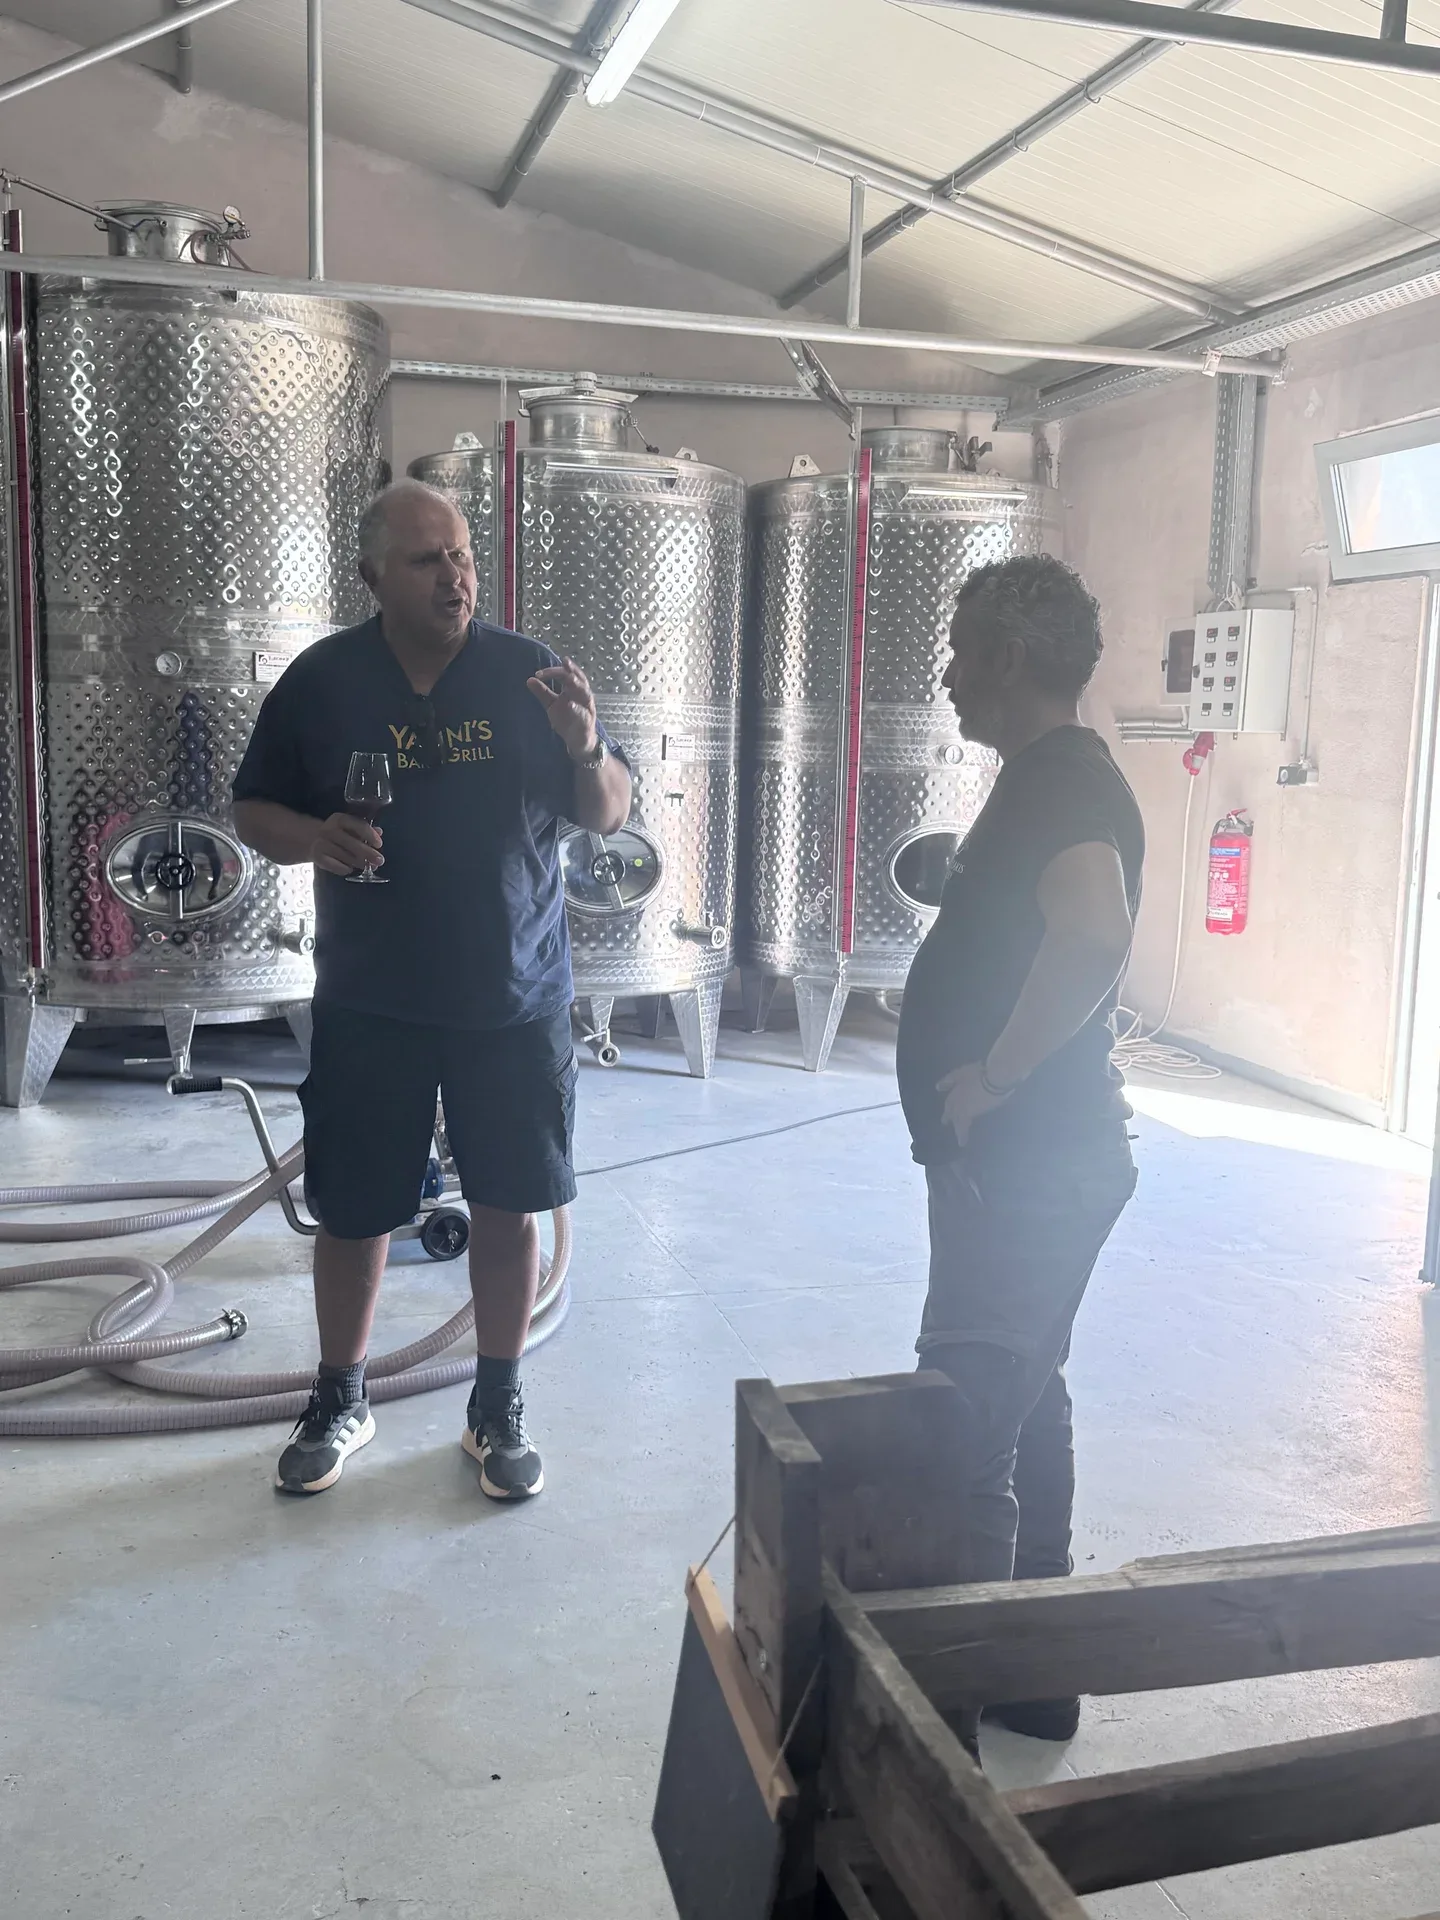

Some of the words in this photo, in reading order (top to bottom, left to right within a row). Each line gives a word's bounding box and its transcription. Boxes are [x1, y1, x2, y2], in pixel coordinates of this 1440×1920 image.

[388, 720, 493, 750] YANI'S
[397, 752, 430, 769] BA
[448, 746, 495, 763] GRILL
